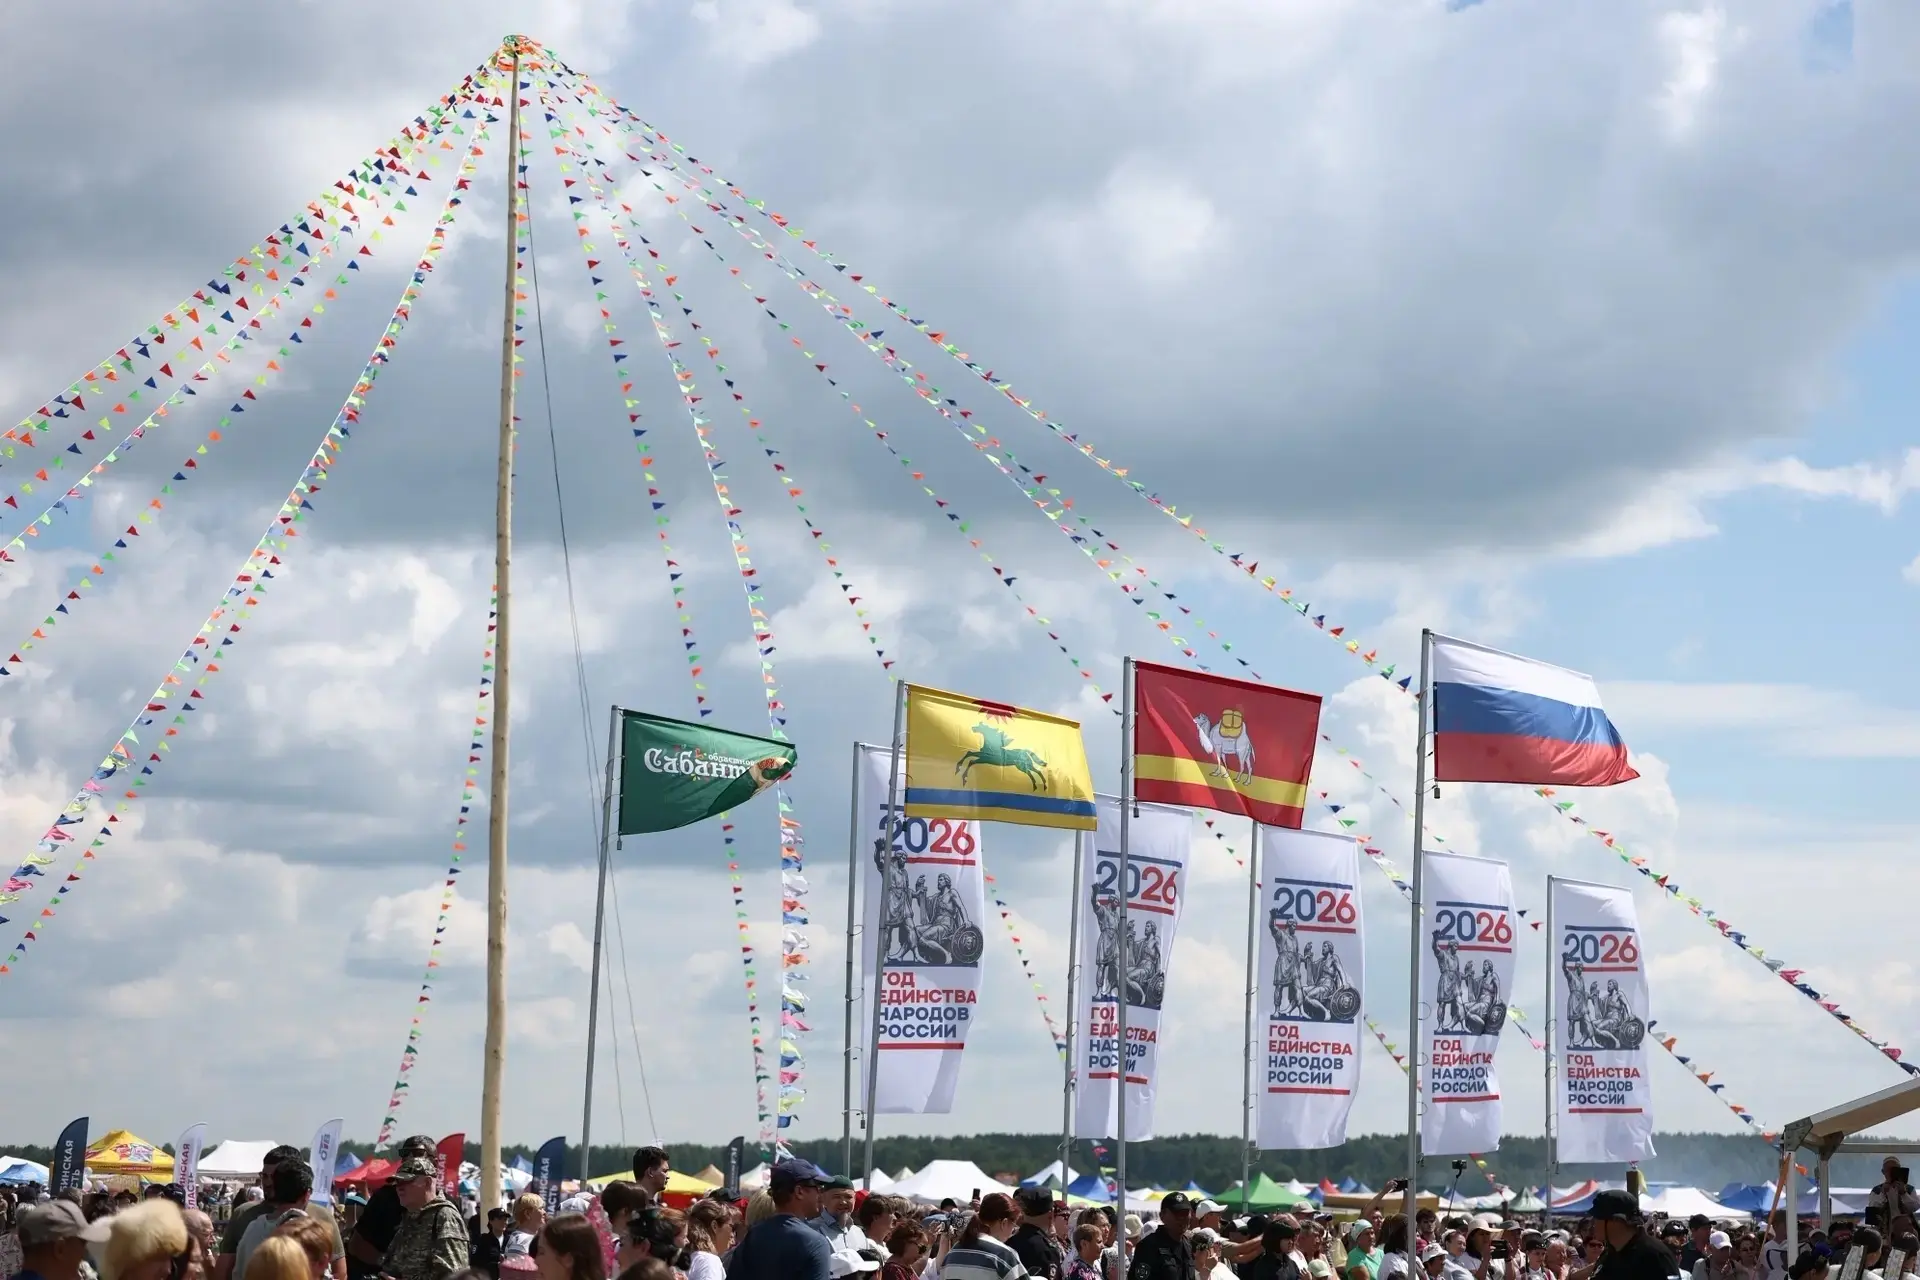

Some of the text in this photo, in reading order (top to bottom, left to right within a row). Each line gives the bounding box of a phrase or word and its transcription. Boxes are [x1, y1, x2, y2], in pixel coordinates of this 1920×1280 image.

[644, 748, 751, 779] Сабант
[879, 815, 975, 855] 2026
[1096, 861, 1178, 905] 2026
[1273, 887, 1356, 924] 2026
[1436, 910, 1512, 944] 2026
[1564, 933, 1638, 963] 2026
[1269, 1025, 1299, 1039] ГОД
[1268, 1040, 1353, 1055] ЕДИНСТВА
[1433, 1039, 1462, 1052] ГОД
[1268, 1055, 1344, 1070] НАРОДОВ
[1567, 1054, 1594, 1067] ГОД
[1268, 1071, 1332, 1085] РОССИИ
[1432, 1067, 1489, 1080] НАРОДО
[1567, 1067, 1641, 1080] ЕДИНСТВА
[1432, 1081, 1488, 1093] РОССИИ
[1568, 1080, 1633, 1093] НАРОДОВ
[1568, 1094, 1625, 1105] РОССИИ
